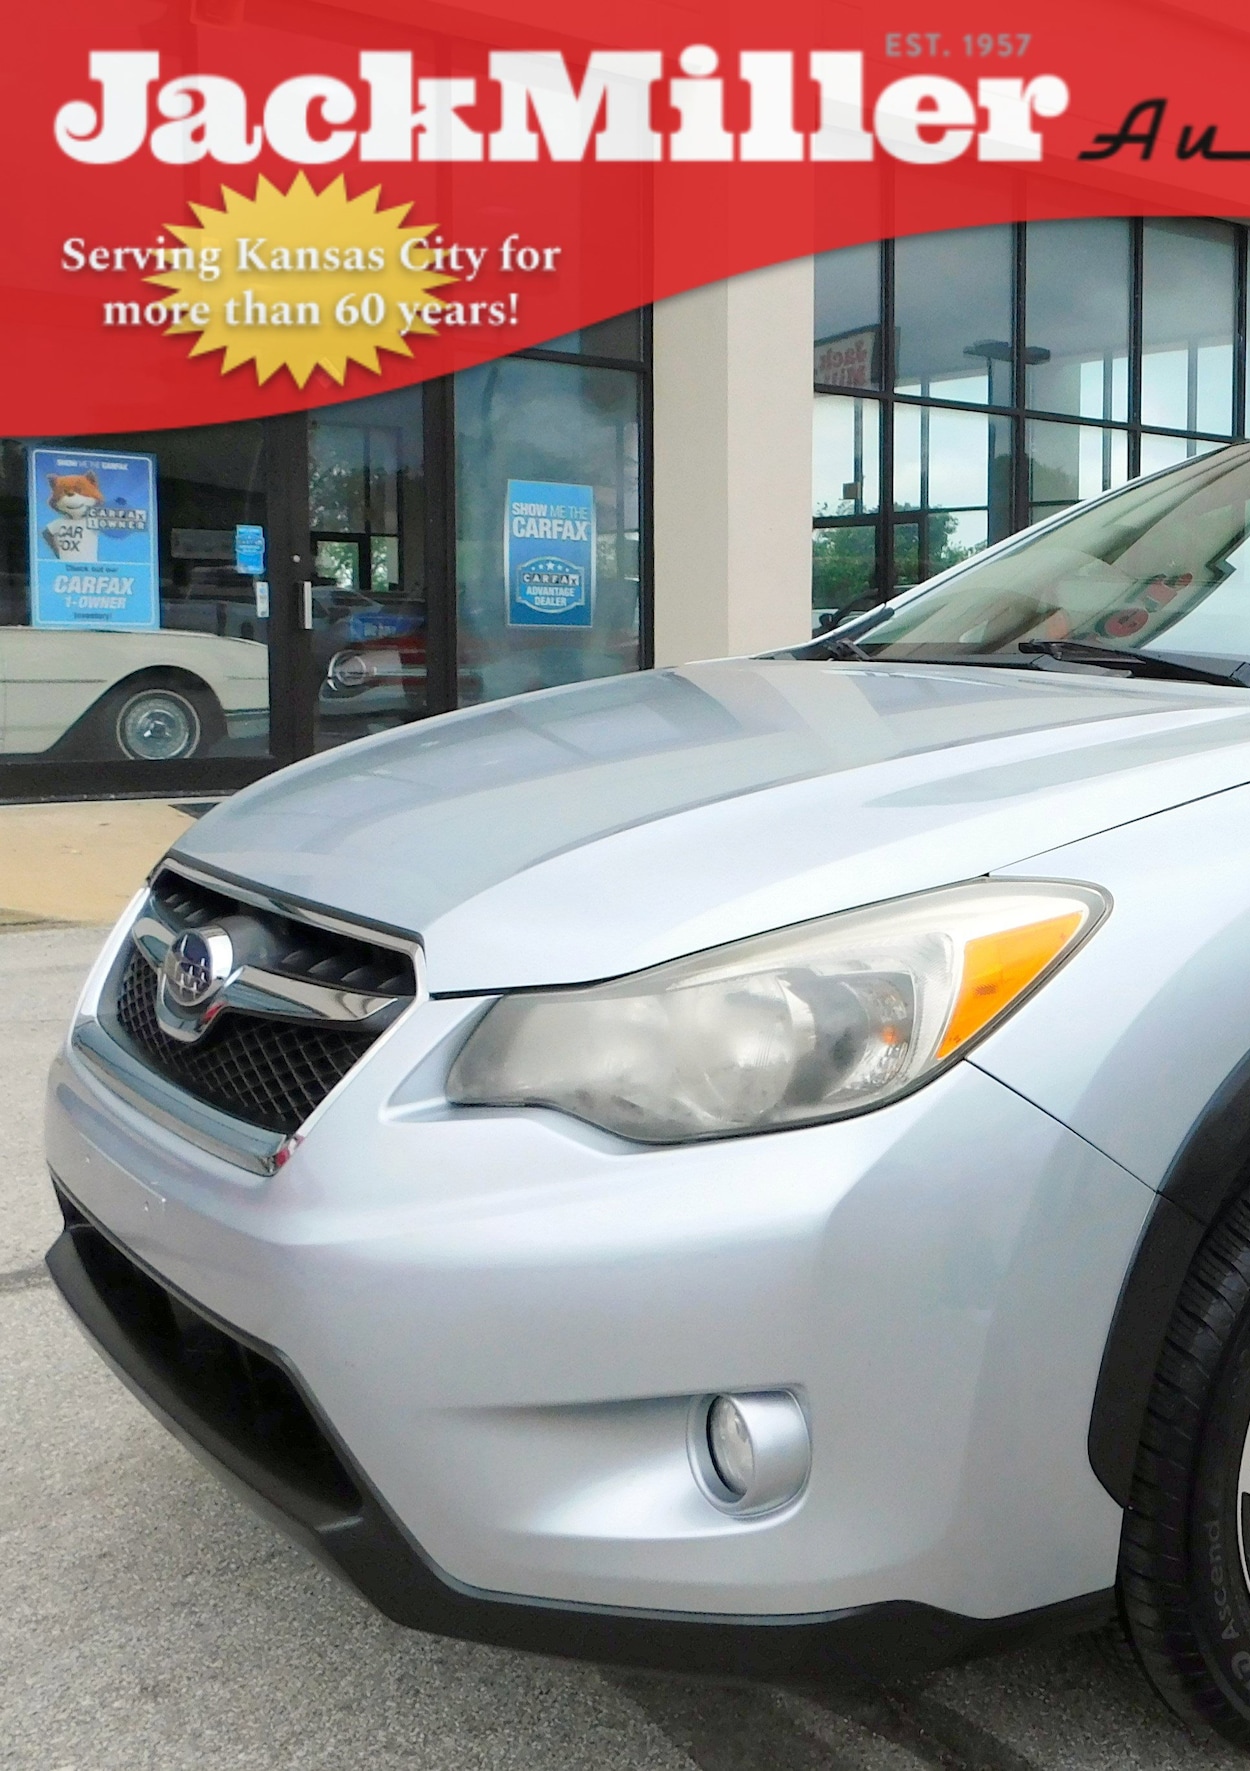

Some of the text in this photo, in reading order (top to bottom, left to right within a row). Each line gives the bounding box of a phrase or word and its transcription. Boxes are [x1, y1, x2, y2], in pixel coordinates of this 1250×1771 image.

[88, 507, 147, 521] CARFAX
[511, 502, 588, 520] SHOW ME THE
[59, 525, 84, 539] CAR
[512, 516, 591, 541] CARFAX
[54, 575, 135, 595] CARFAX
[523, 573, 579, 586] CARFAX
[526, 586, 575, 597] ADVANTAGE
[534, 596, 567, 607] DEALER
